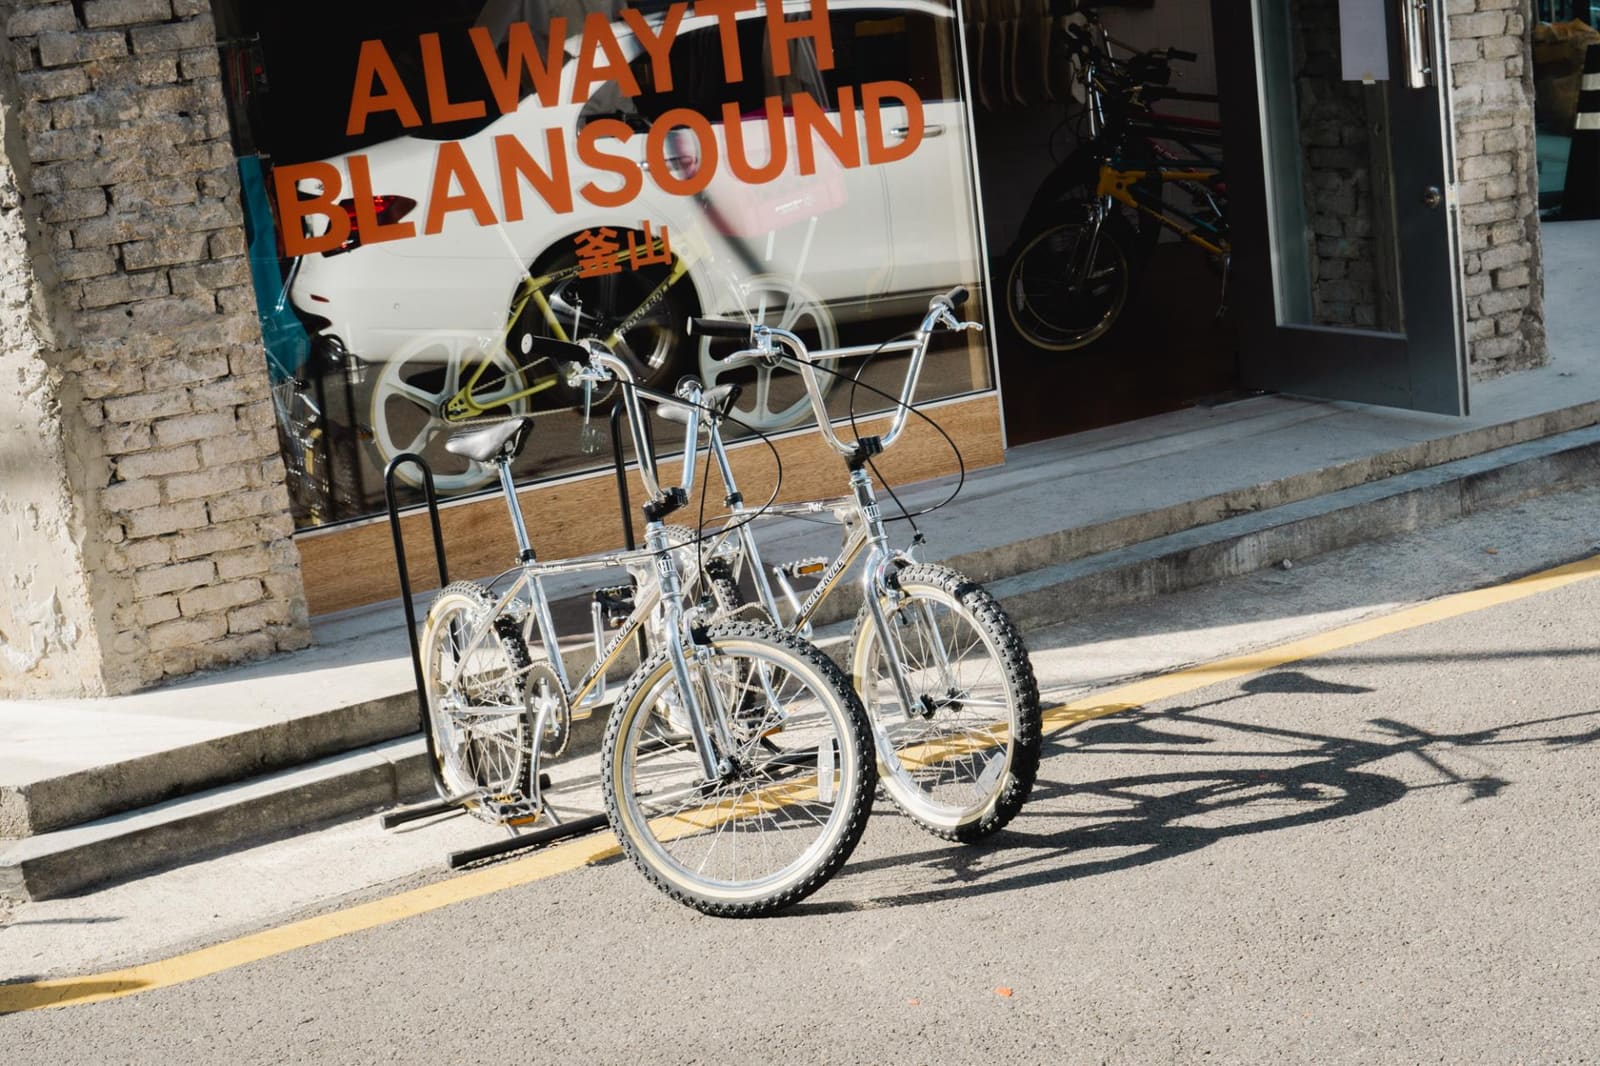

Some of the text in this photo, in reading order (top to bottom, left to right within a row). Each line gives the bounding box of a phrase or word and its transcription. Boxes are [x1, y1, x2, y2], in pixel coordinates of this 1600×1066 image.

[348, 0, 835, 135] ALWAYTH
[274, 80, 925, 257] BLANSOUND
[574, 220, 672, 278] 釜山
